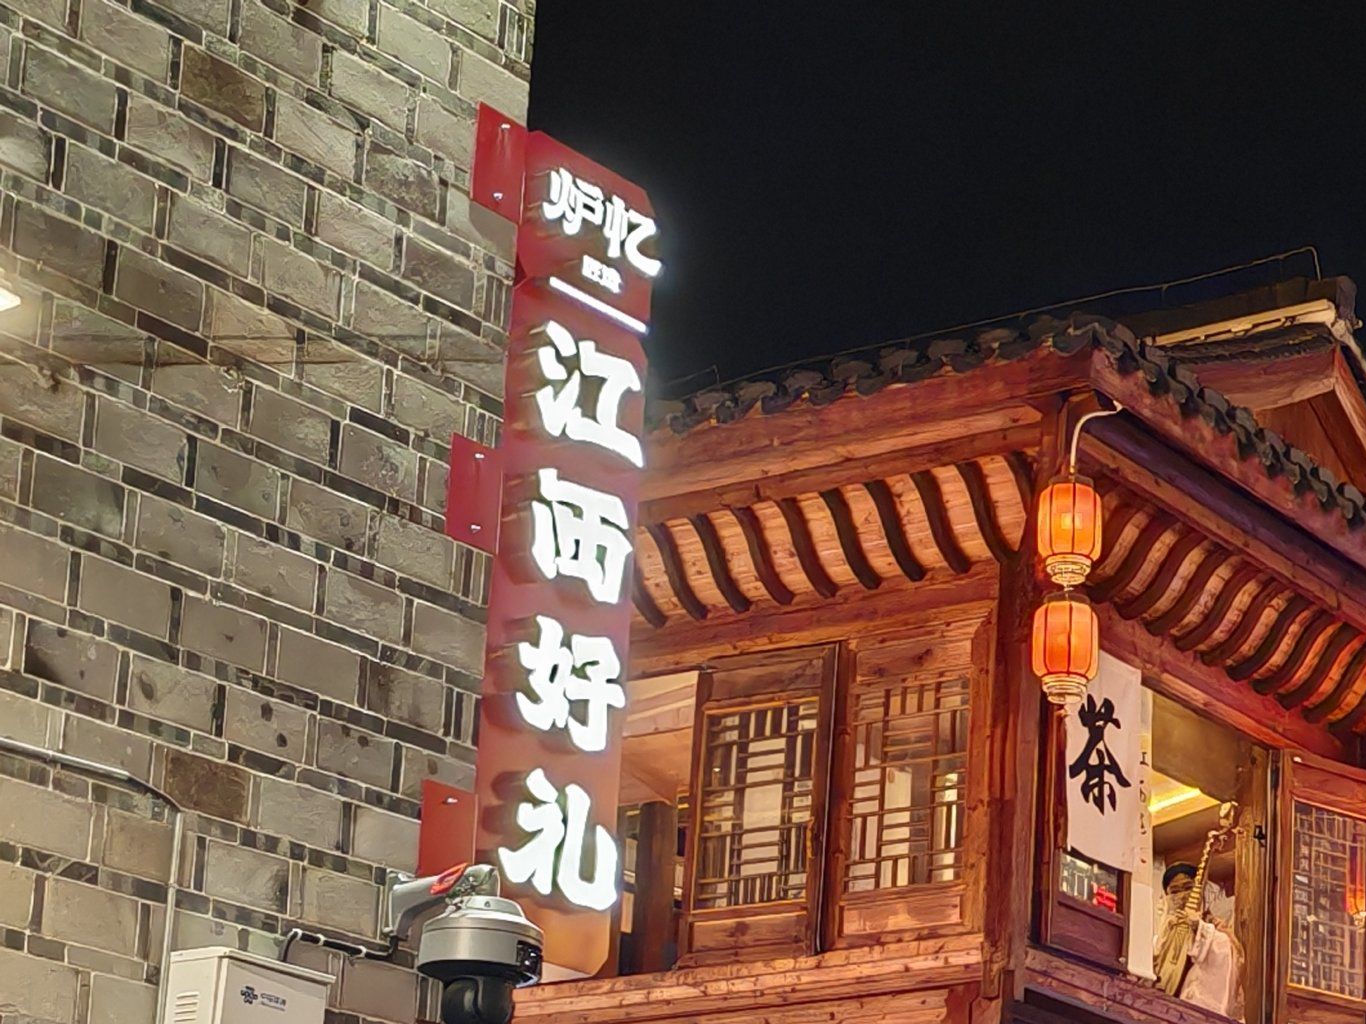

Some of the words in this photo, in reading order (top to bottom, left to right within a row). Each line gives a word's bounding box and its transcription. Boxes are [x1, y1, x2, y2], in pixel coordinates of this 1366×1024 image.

[498, 319, 646, 912] 江西好礼
[1069, 693, 1132, 816] 茶
